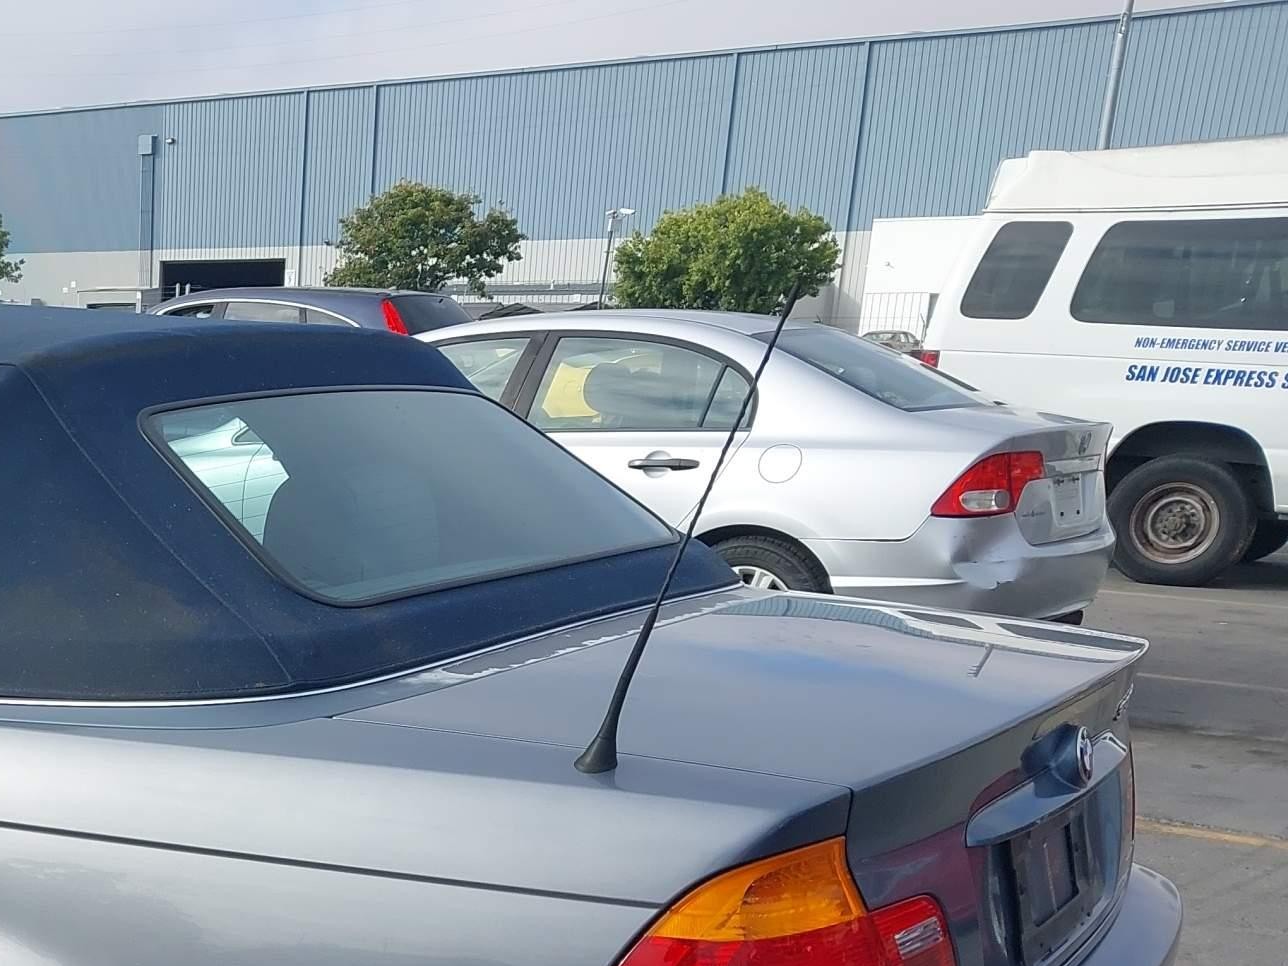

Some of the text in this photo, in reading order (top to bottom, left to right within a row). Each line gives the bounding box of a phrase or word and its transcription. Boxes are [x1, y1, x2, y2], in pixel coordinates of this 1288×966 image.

[1134, 337, 1223, 351] NON-EMERGENCY
[1225, 339, 1273, 353] SERVICE
[1125, 364, 1160, 382] SAN
[1161, 366, 1202, 384] JOSE
[1203, 368, 1279, 388] EXPRESS
